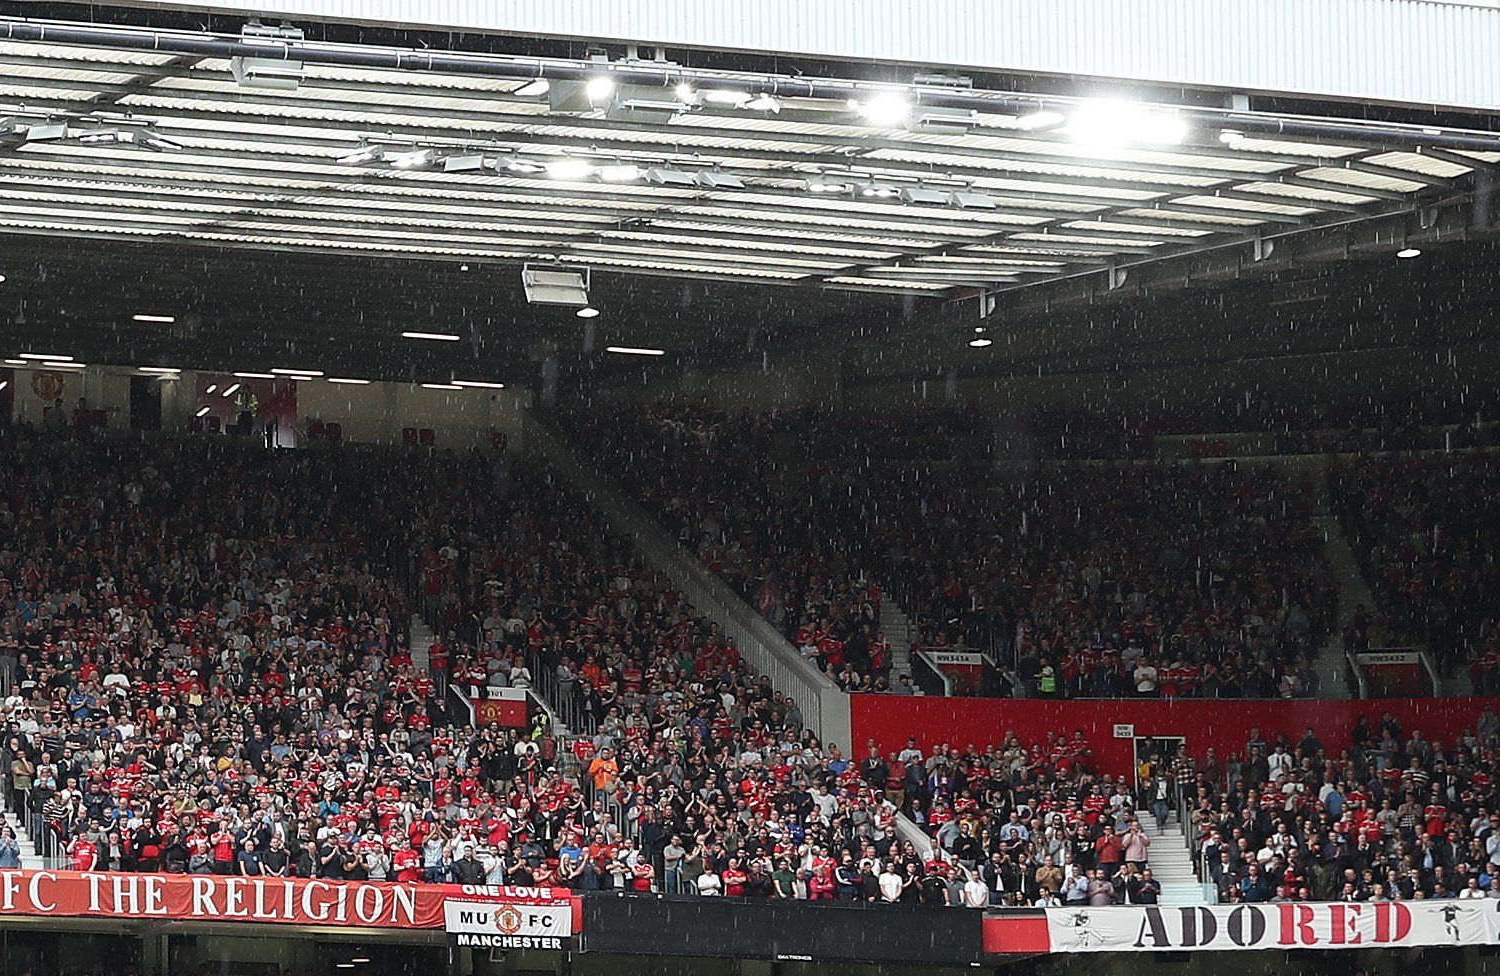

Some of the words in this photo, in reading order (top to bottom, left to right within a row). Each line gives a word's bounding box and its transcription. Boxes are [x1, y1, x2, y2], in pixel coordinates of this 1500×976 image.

[80, 872, 167, 916] THE
[191, 876, 417, 926] RELIGION
[461, 884, 500, 897] ONE
[505, 886, 552, 899] LOVE
[1134, 901, 1412, 948] ADORED
[457, 934, 562, 950] MANCHESTER
